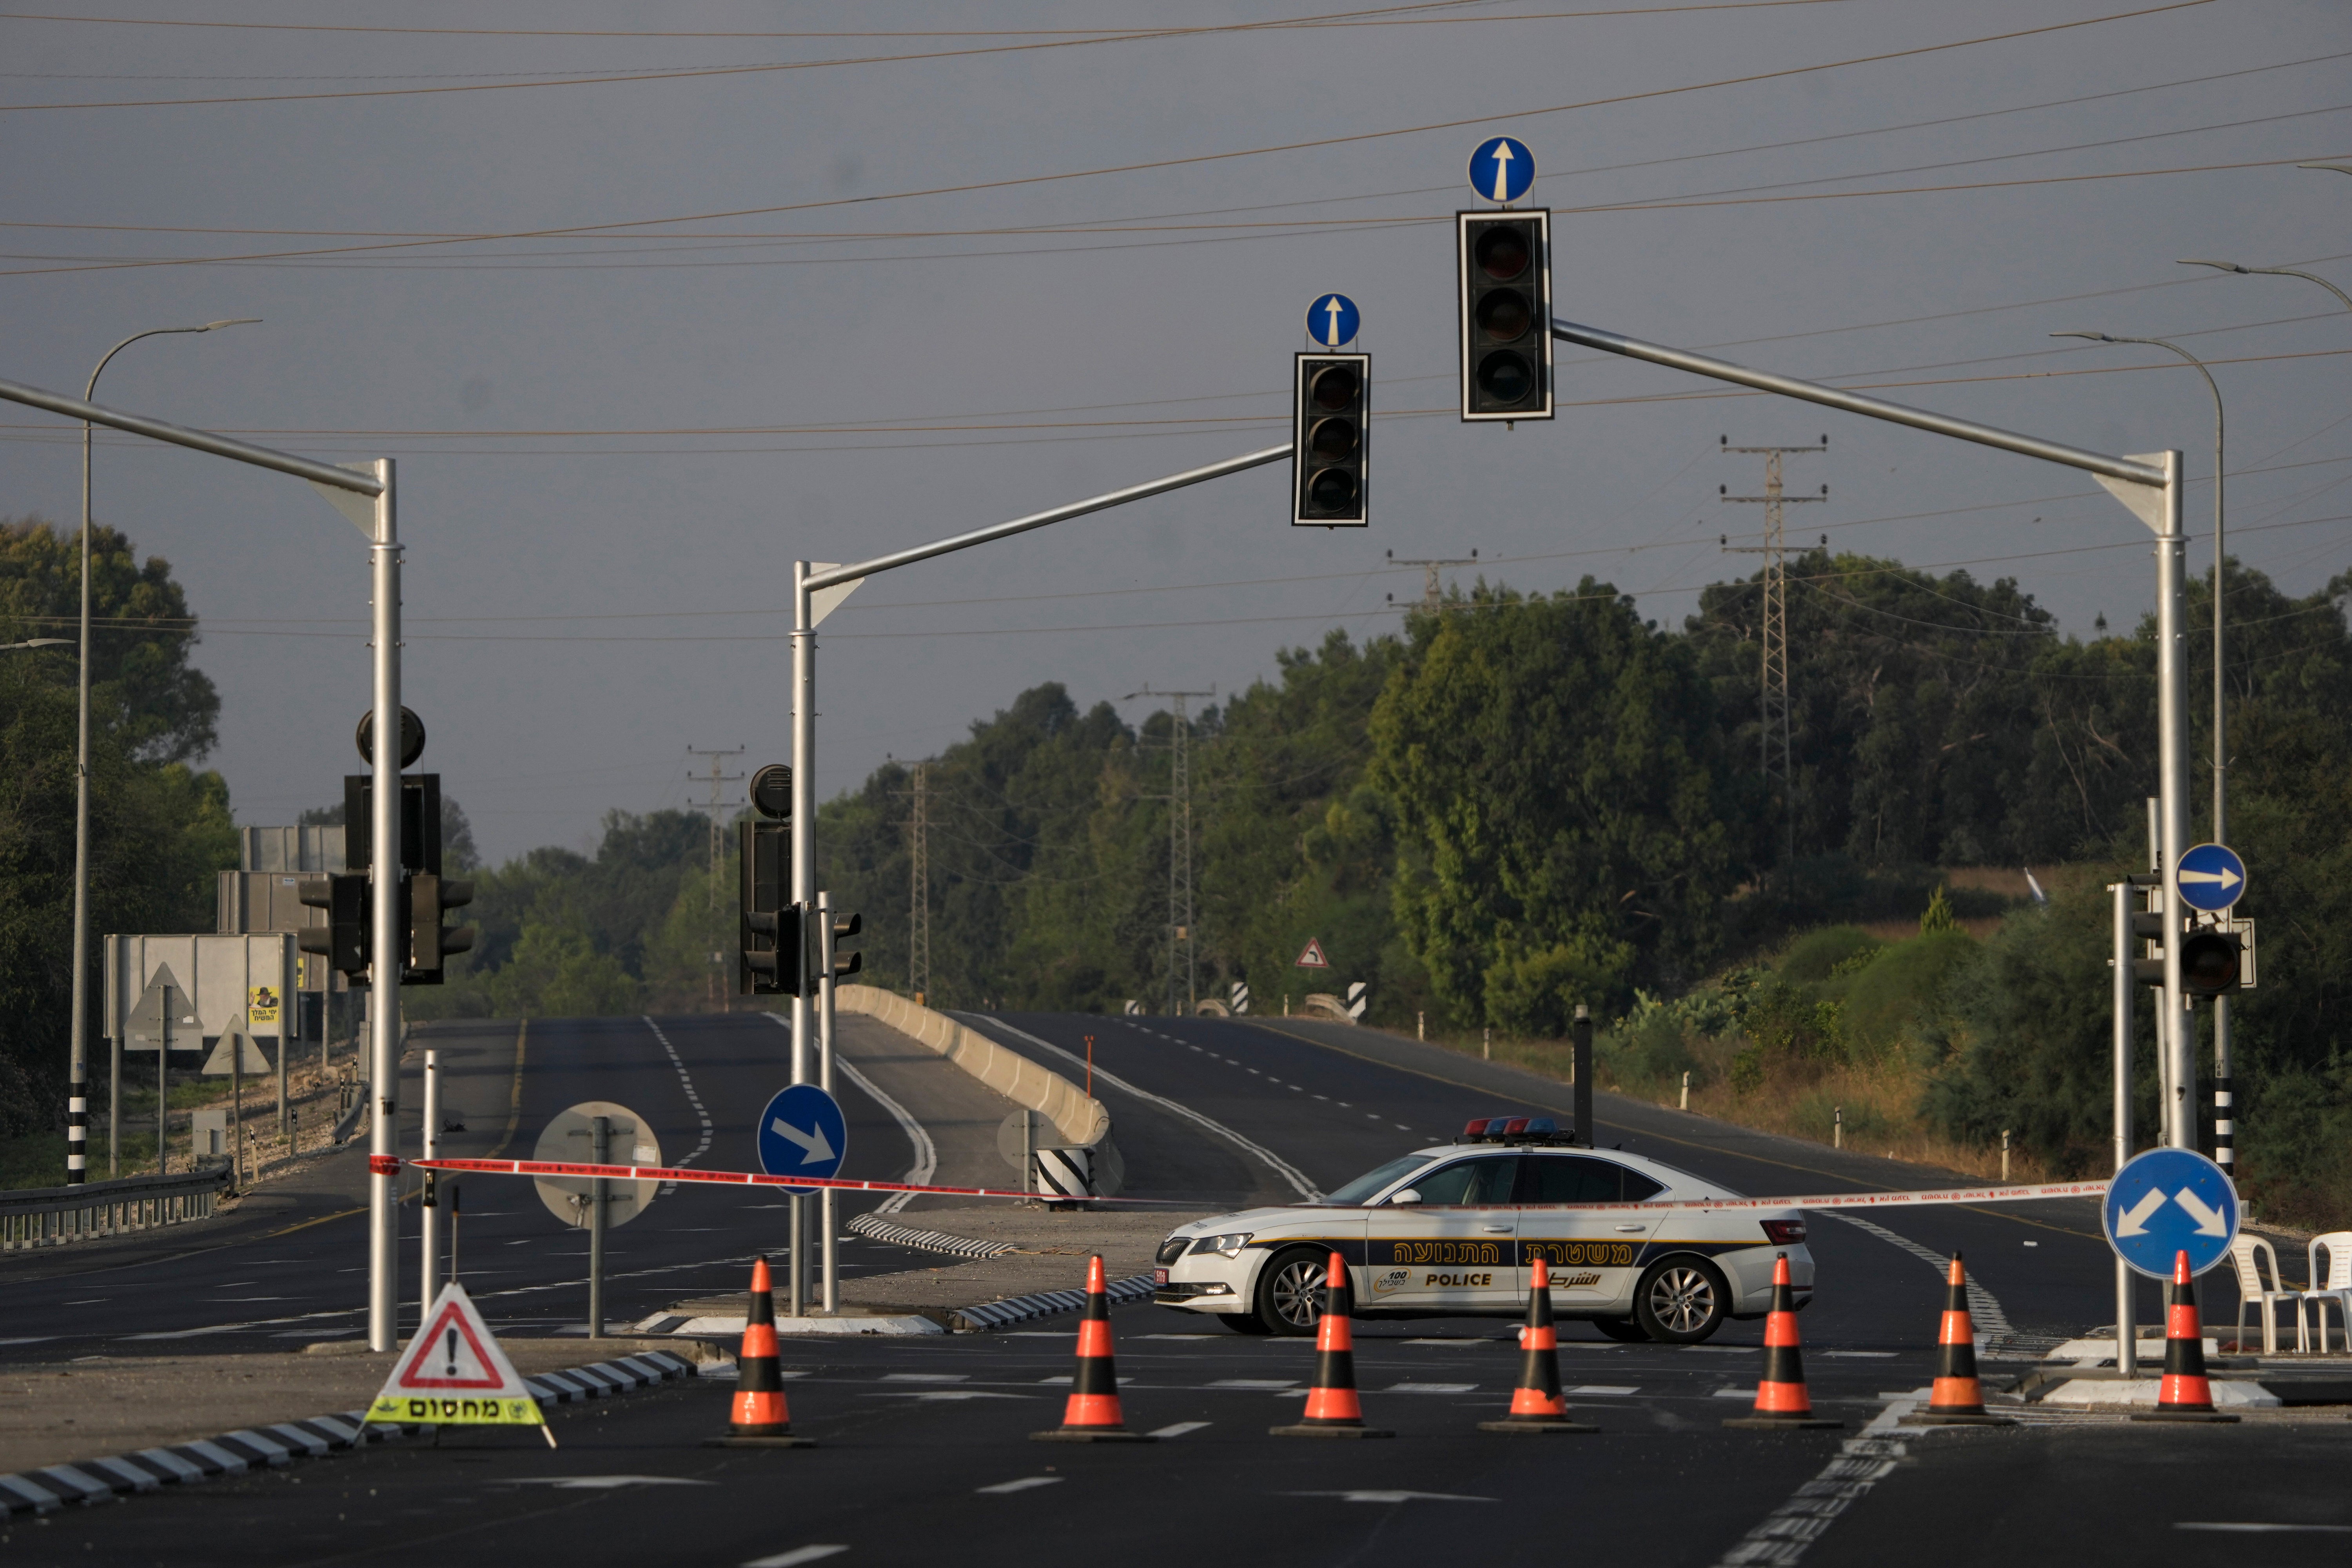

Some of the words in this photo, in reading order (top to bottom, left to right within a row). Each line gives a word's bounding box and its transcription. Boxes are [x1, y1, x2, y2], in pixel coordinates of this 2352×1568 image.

[1395, 1243, 1499, 1263] התנועה
[1526, 1244, 1632, 1264] משטרת
[1379, 1279, 1405, 1288] בשבילך
[1425, 1274, 1492, 1286] POLICE
[1549, 1272, 1602, 1289] الشرط
[409, 1399, 499, 1417] מחסום
